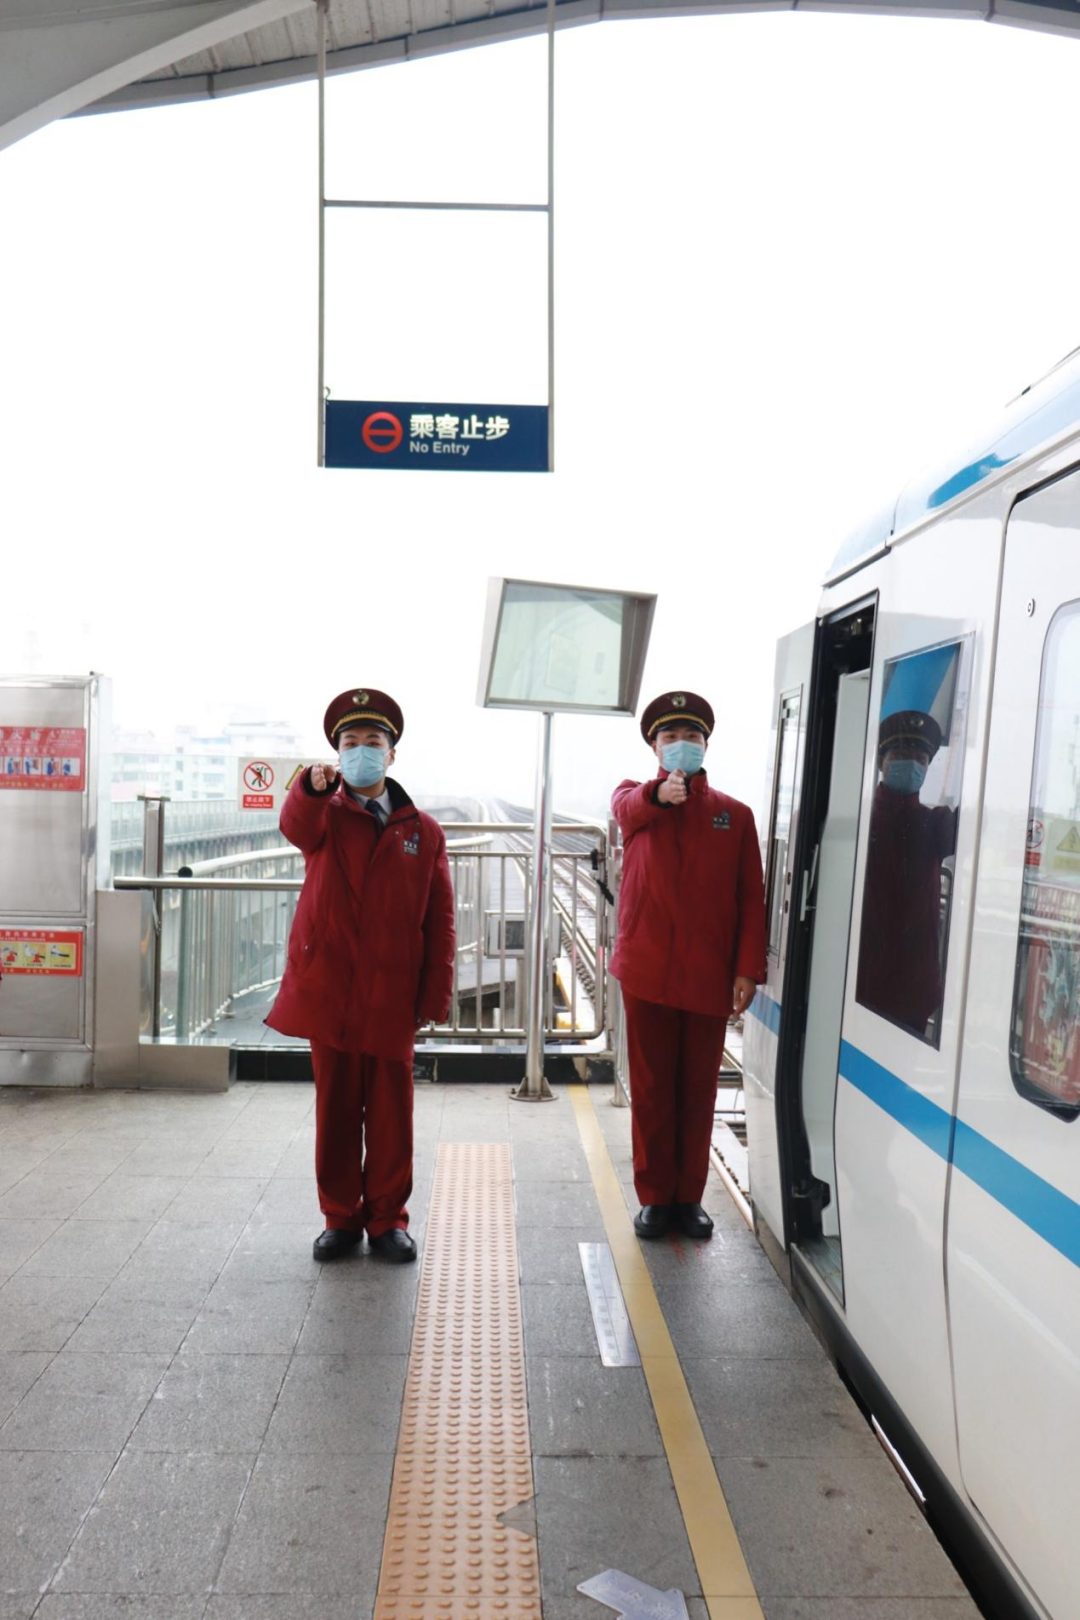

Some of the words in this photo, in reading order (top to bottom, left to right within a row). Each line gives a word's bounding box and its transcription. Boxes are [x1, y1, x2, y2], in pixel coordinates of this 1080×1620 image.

[410, 413, 510, 441] 乘客止步
[409, 441, 429, 453] No
[433, 441, 470, 456] Entry
